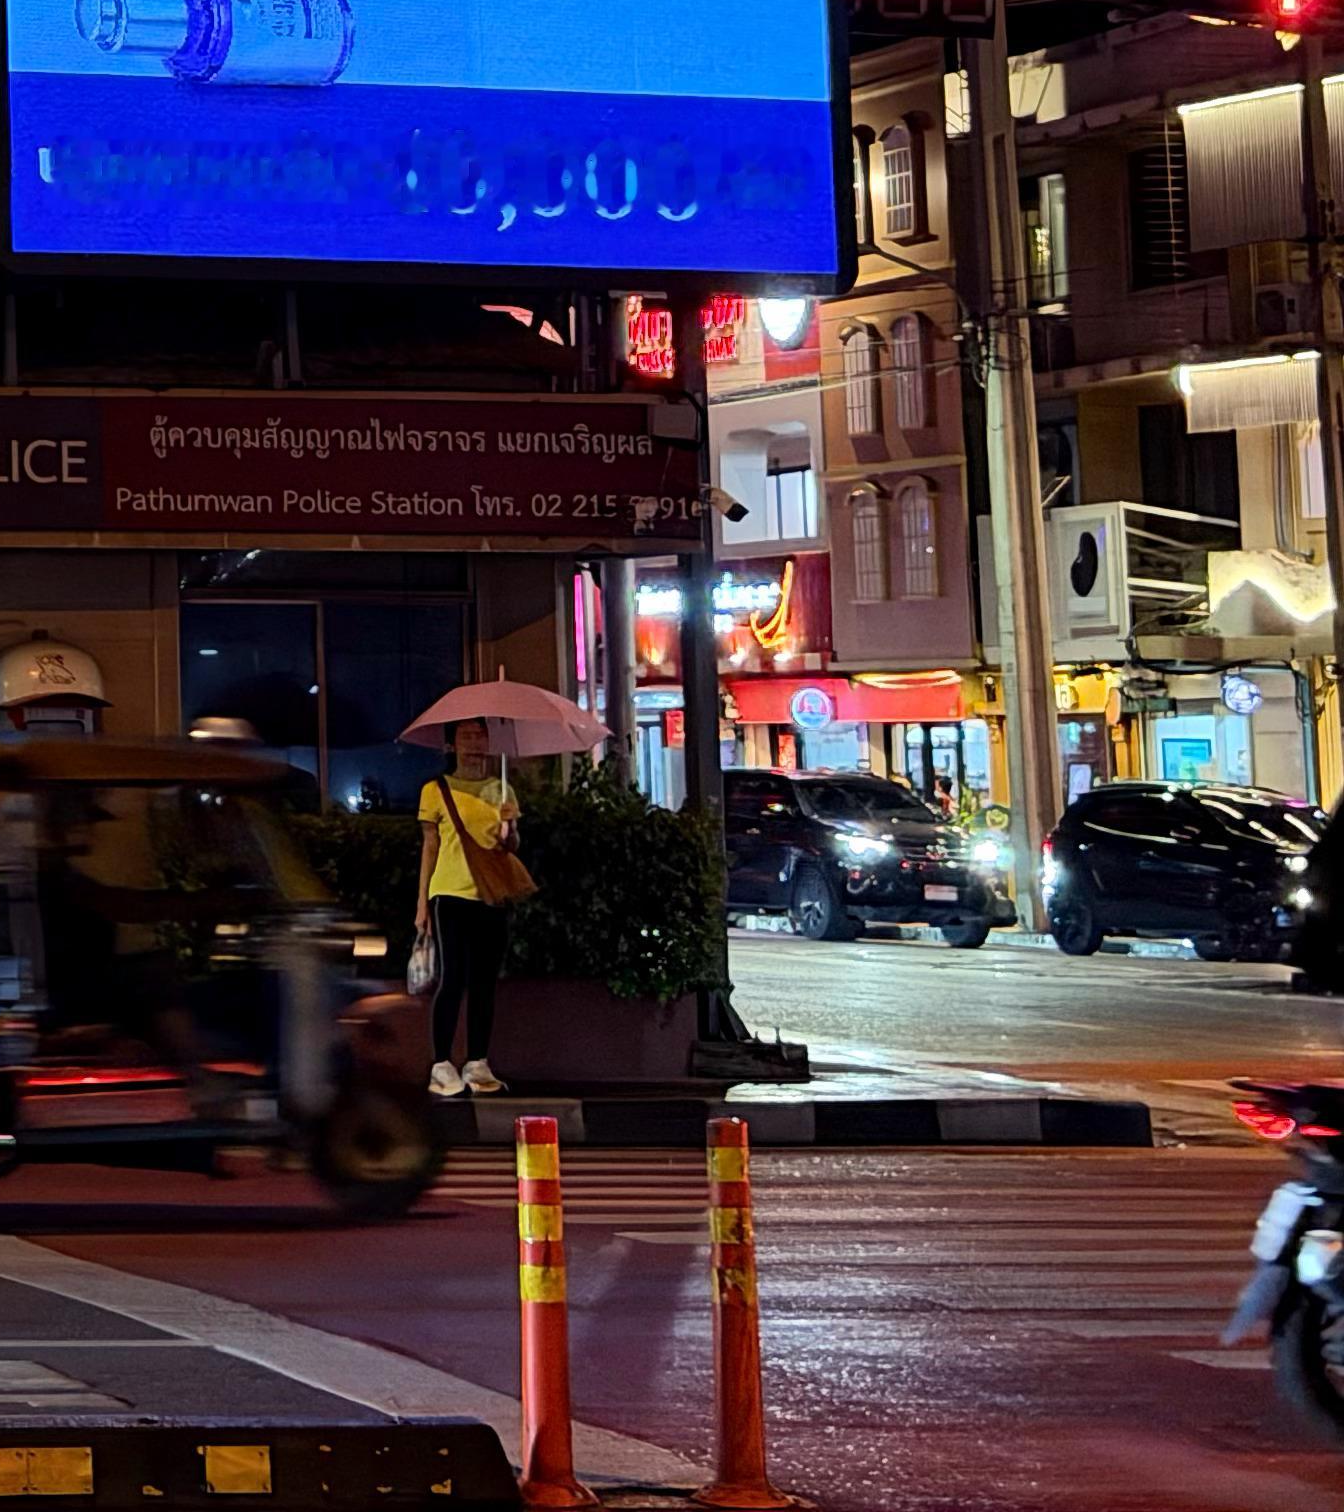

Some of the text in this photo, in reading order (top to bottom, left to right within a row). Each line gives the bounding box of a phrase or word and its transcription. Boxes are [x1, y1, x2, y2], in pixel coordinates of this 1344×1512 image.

[150, 414, 654, 464] ตู้ควบคุมสัญญาณไฟจราจร แยกเจริญผล
[116, 486, 273, 514] Pathumwan
[283, 488, 363, 515] Police
[370, 490, 464, 517] Station
[469, 484, 522, 517] โทร.
[531, 493, 563, 518] 02
[571, 494, 618, 519] 215
